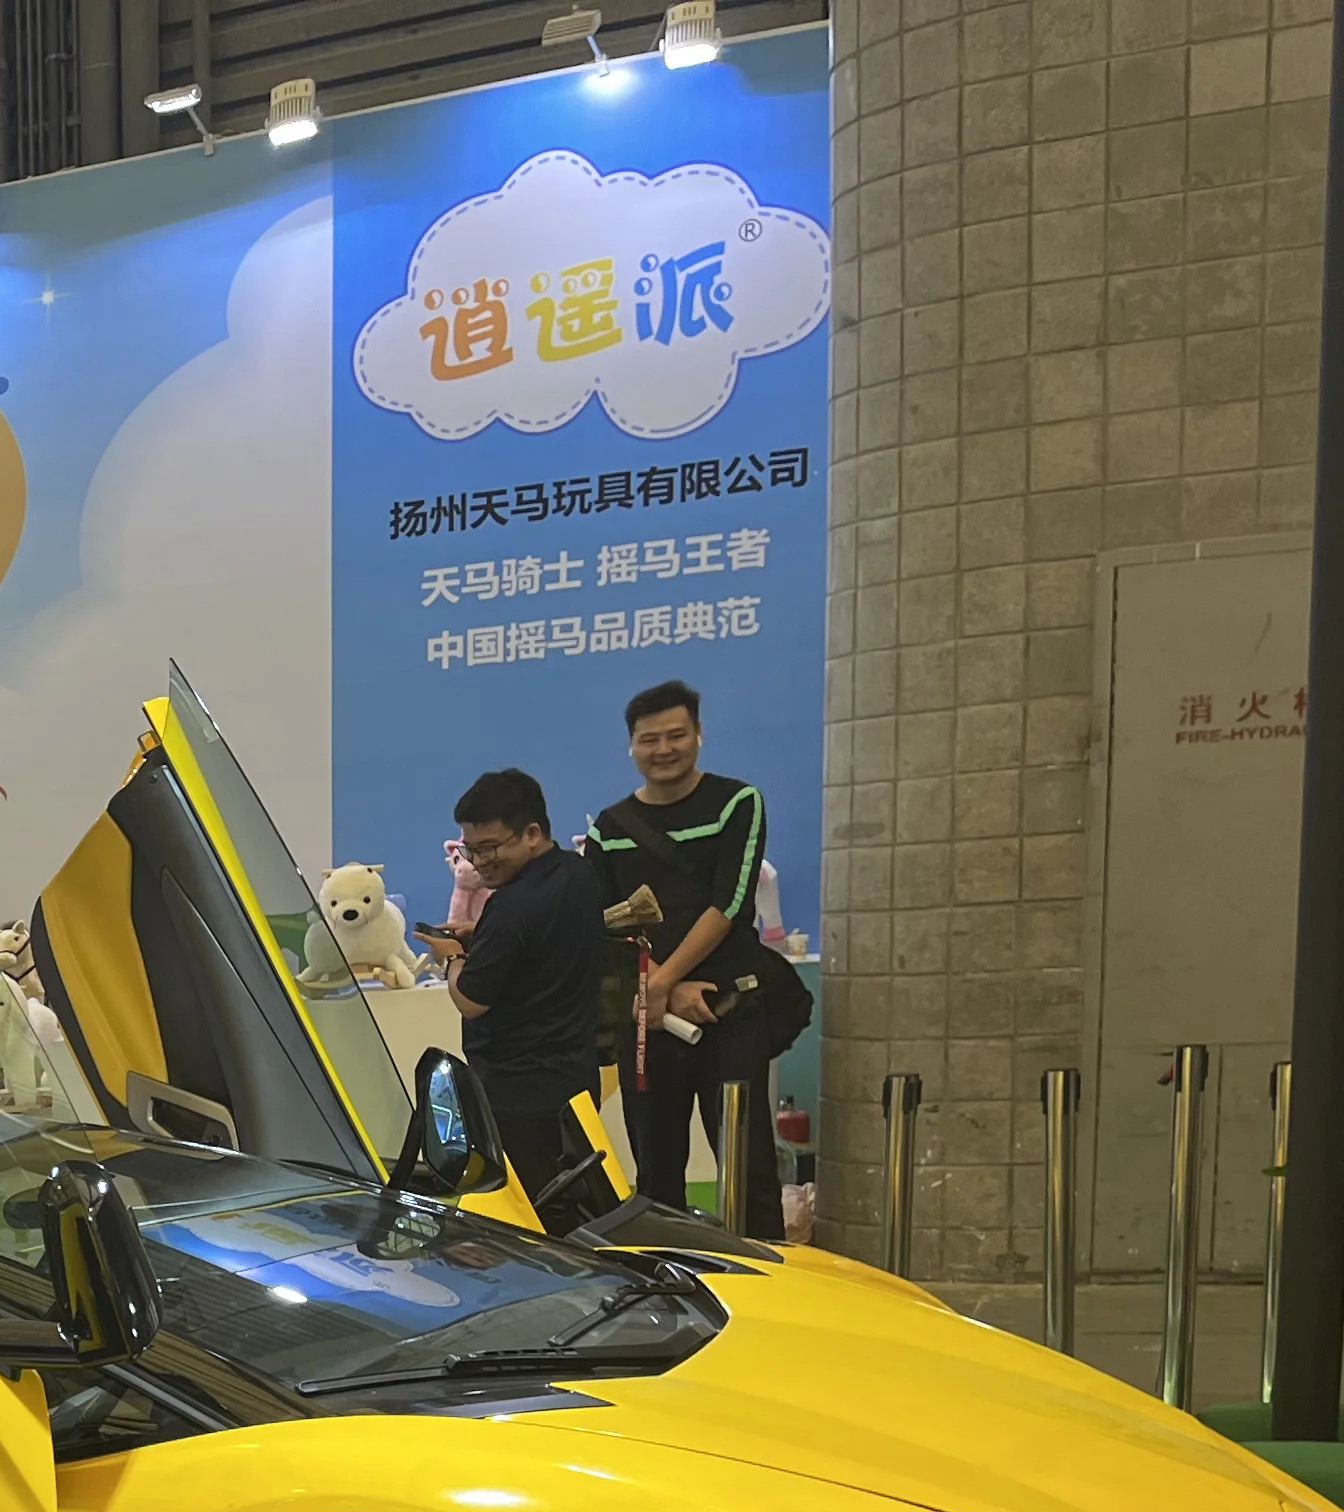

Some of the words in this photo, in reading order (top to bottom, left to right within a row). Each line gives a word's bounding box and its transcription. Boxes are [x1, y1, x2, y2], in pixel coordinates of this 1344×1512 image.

[419, 240, 734, 382] 逍遥派
[388, 446, 810, 541] 扬州天马玩具有限公司
[421, 550, 585, 608] 天马骑士
[596, 527, 771, 588] 摇马王者
[425, 596, 763, 671] 中国摇马品质典范
